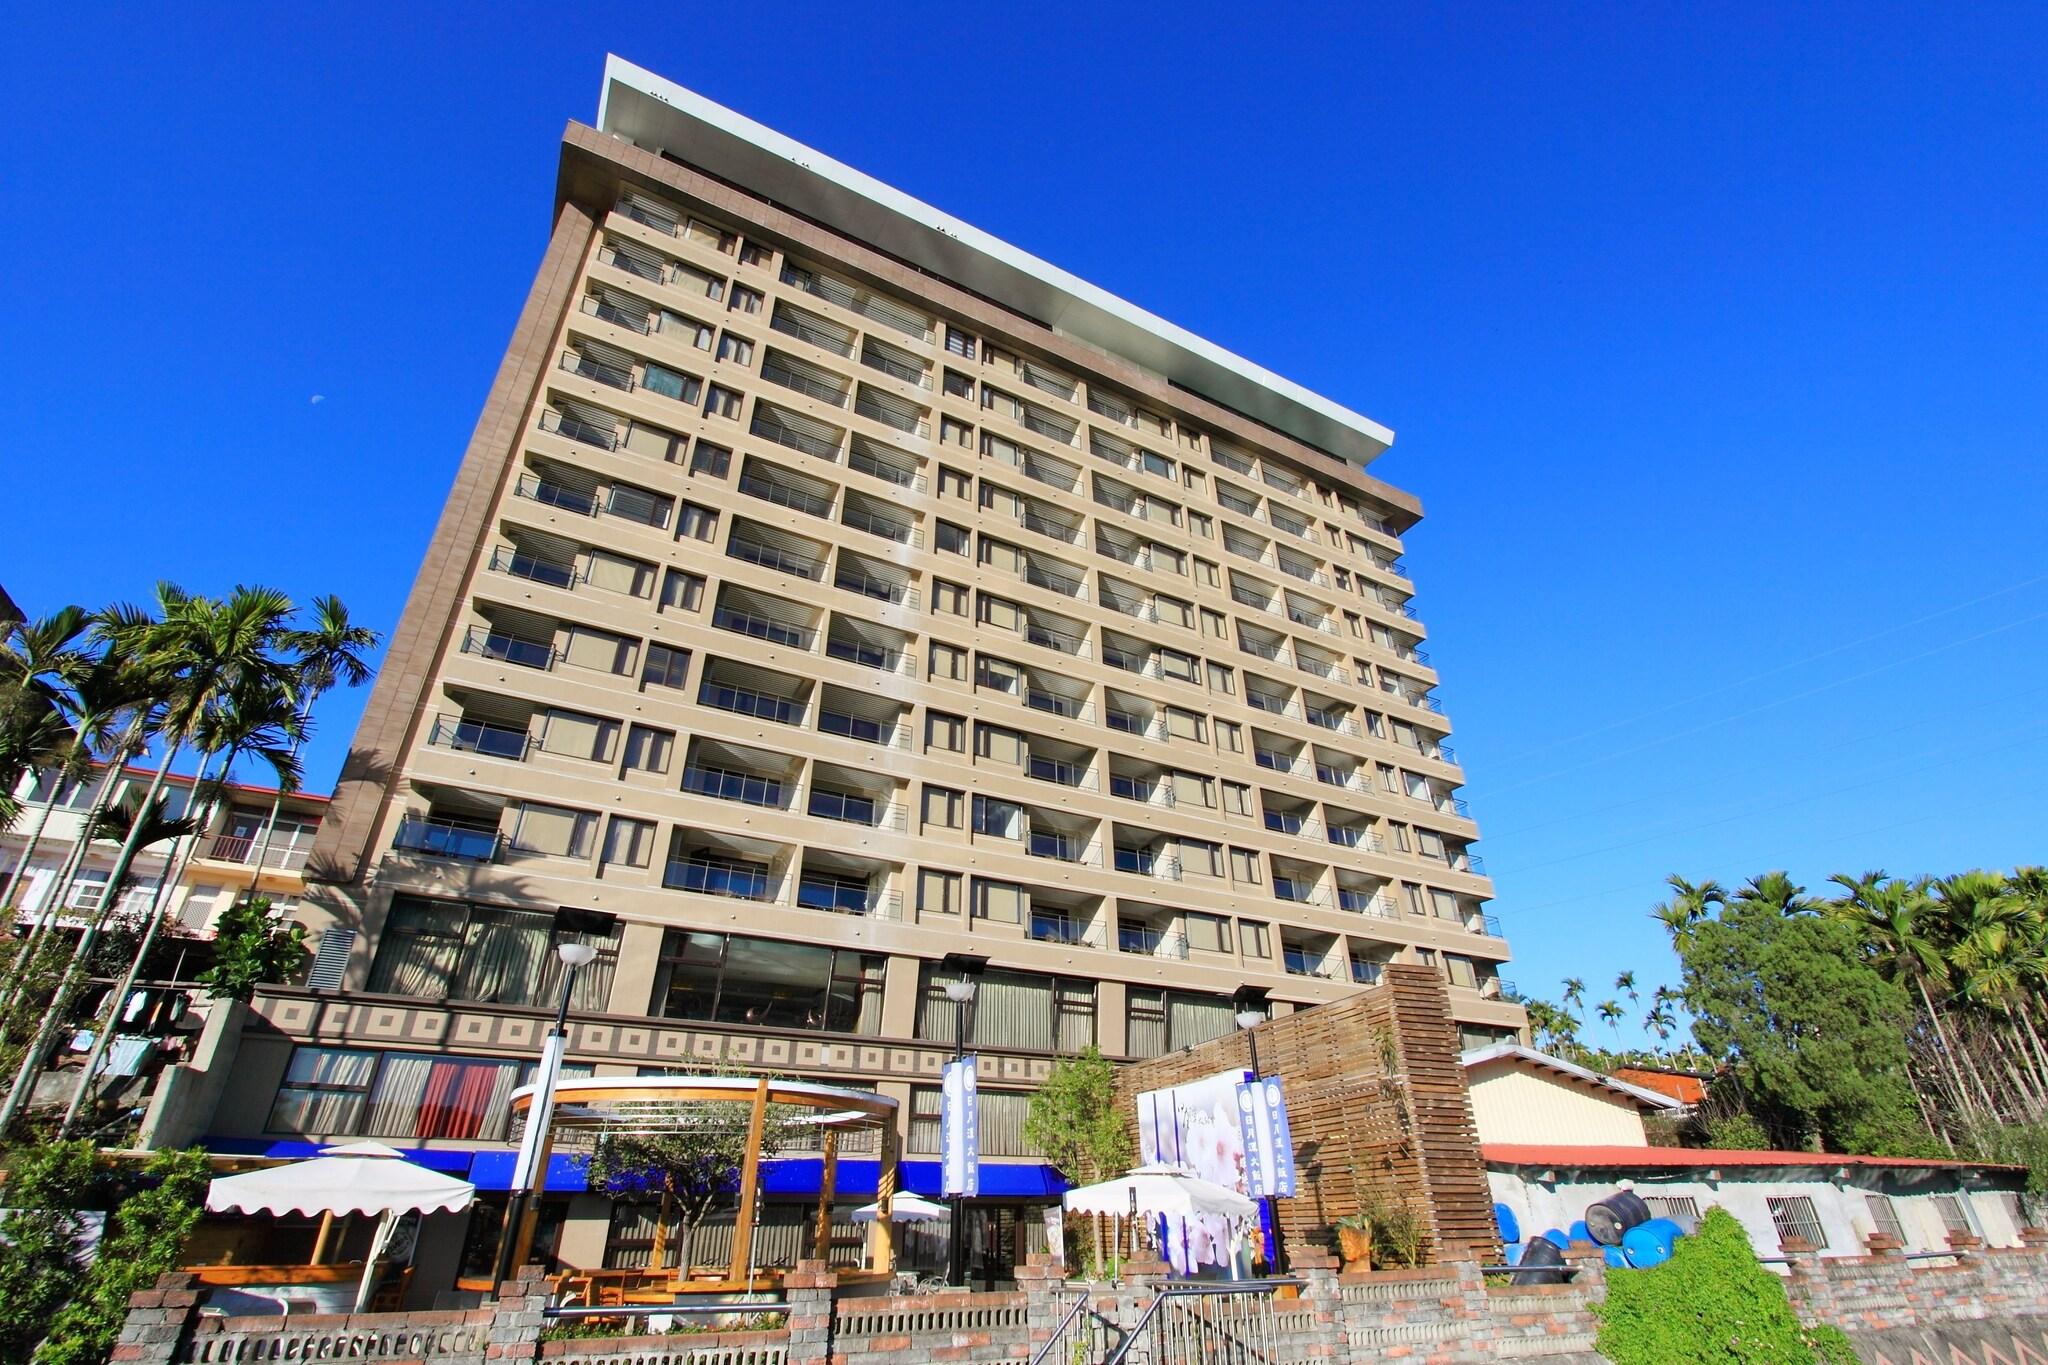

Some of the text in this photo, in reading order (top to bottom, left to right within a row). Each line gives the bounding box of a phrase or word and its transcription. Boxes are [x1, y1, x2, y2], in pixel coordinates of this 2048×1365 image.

[1245, 1115, 1263, 1195] 日月潭大飯店
